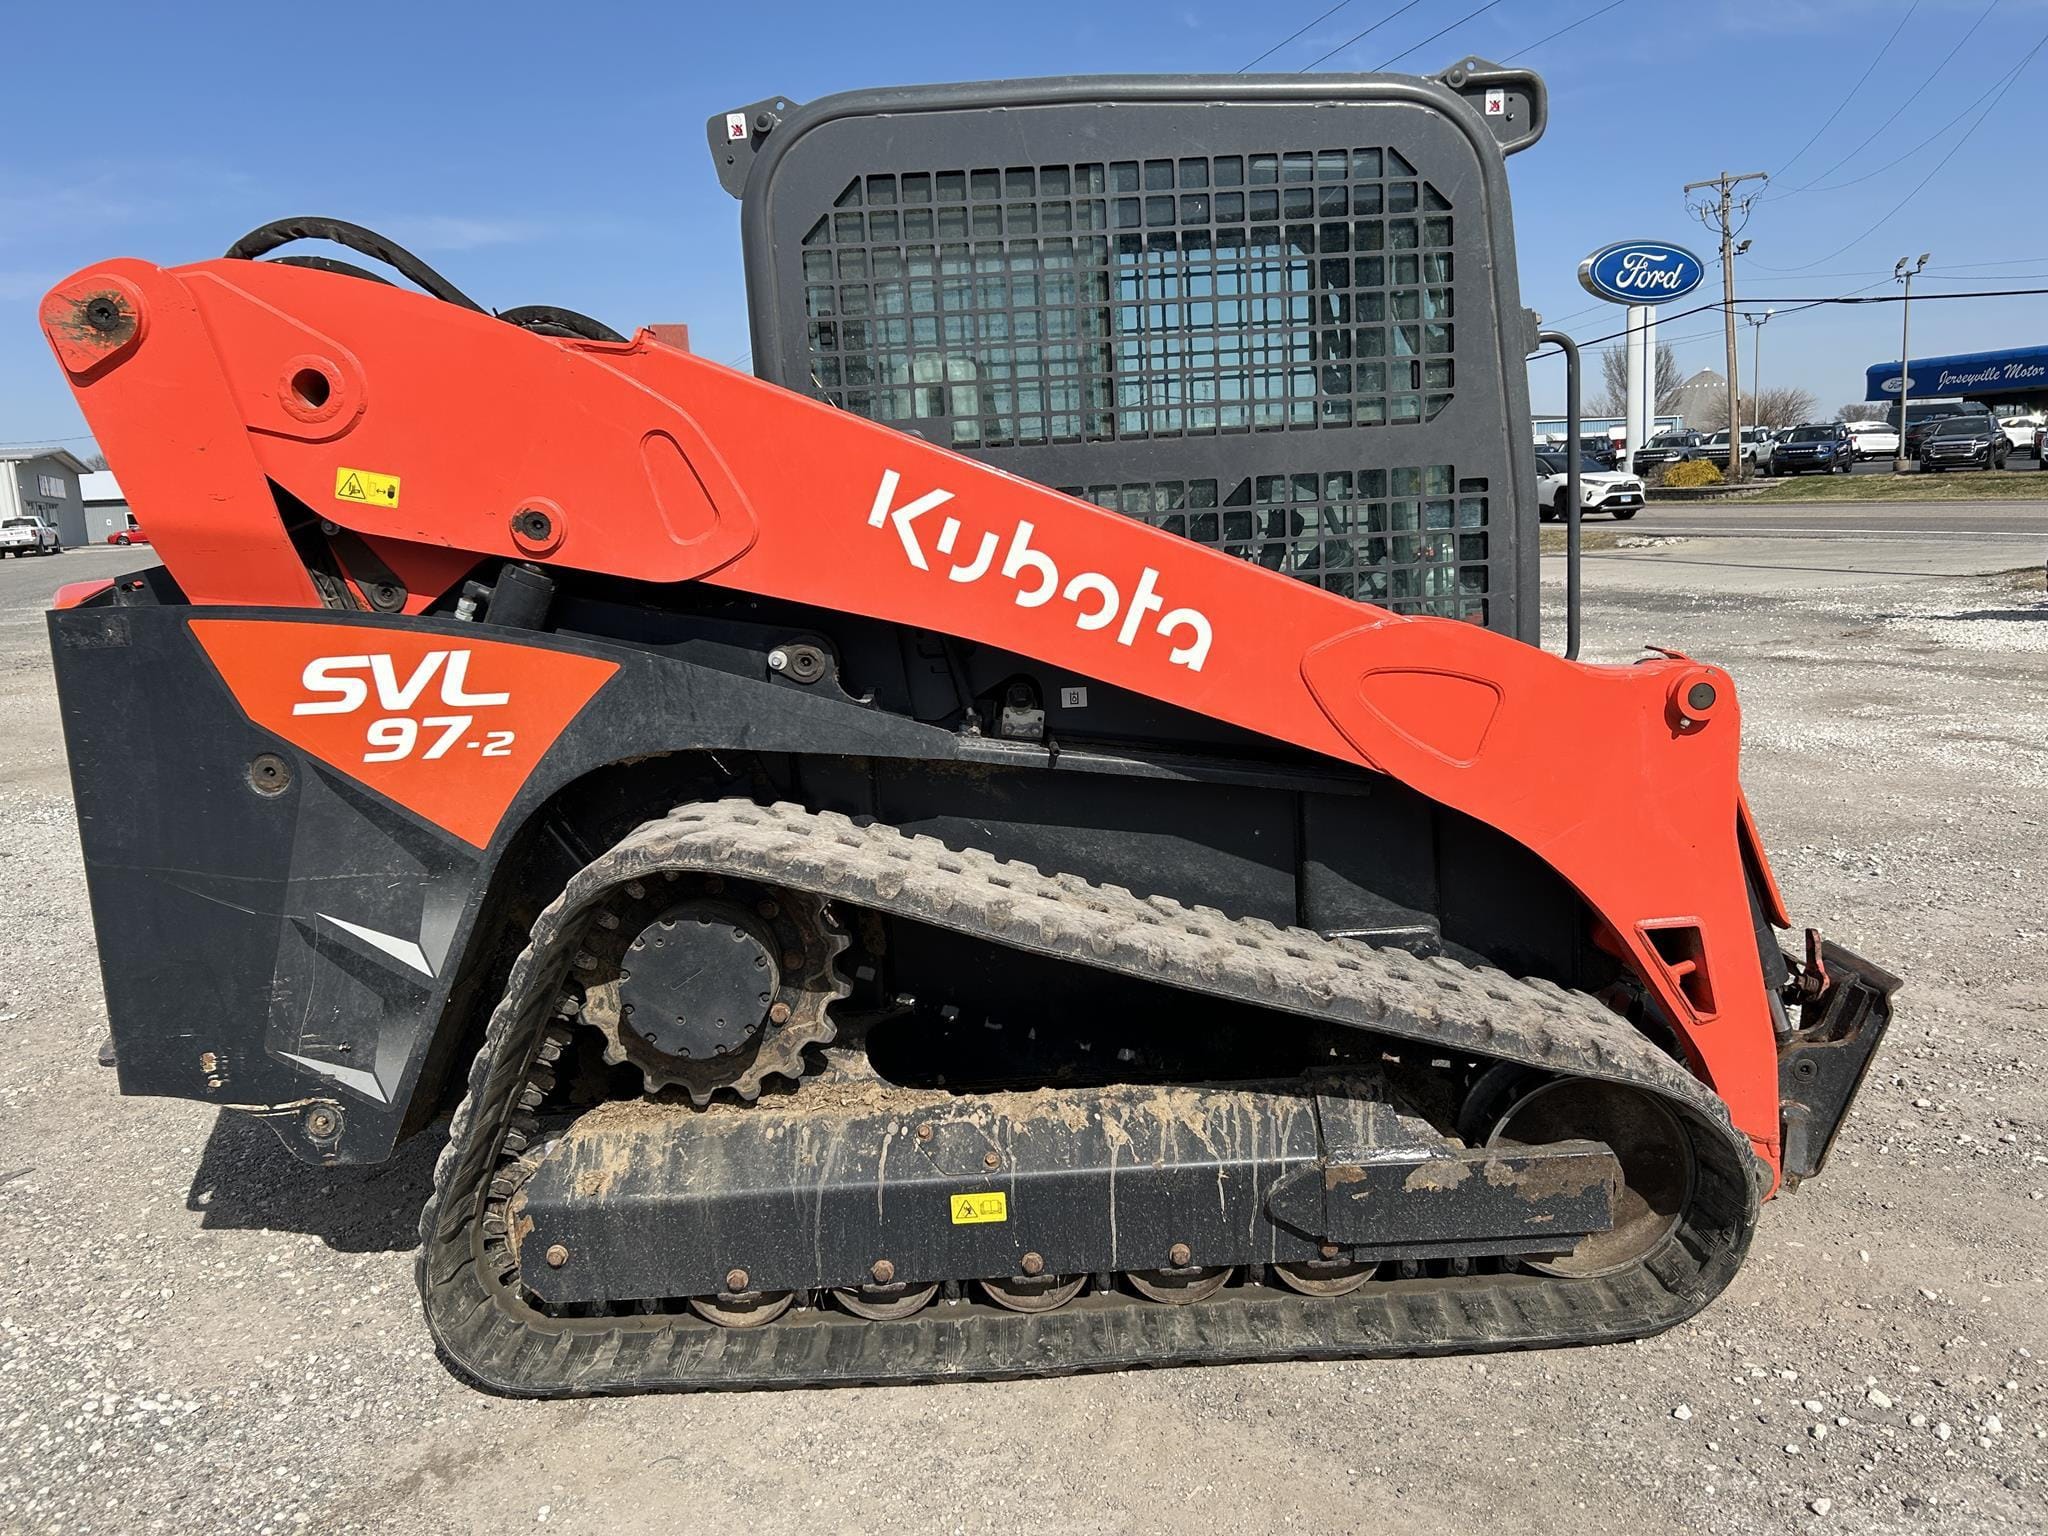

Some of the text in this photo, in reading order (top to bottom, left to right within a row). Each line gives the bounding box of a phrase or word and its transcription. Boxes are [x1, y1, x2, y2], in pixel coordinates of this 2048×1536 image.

[1615, 252, 1684, 289] Ford
[1937, 363, 2046, 391] Jerseyville Motor
[867, 468, 1214, 673] Kubota
[292, 649, 511, 716] SVL
[362, 714, 516, 763] 97-2
